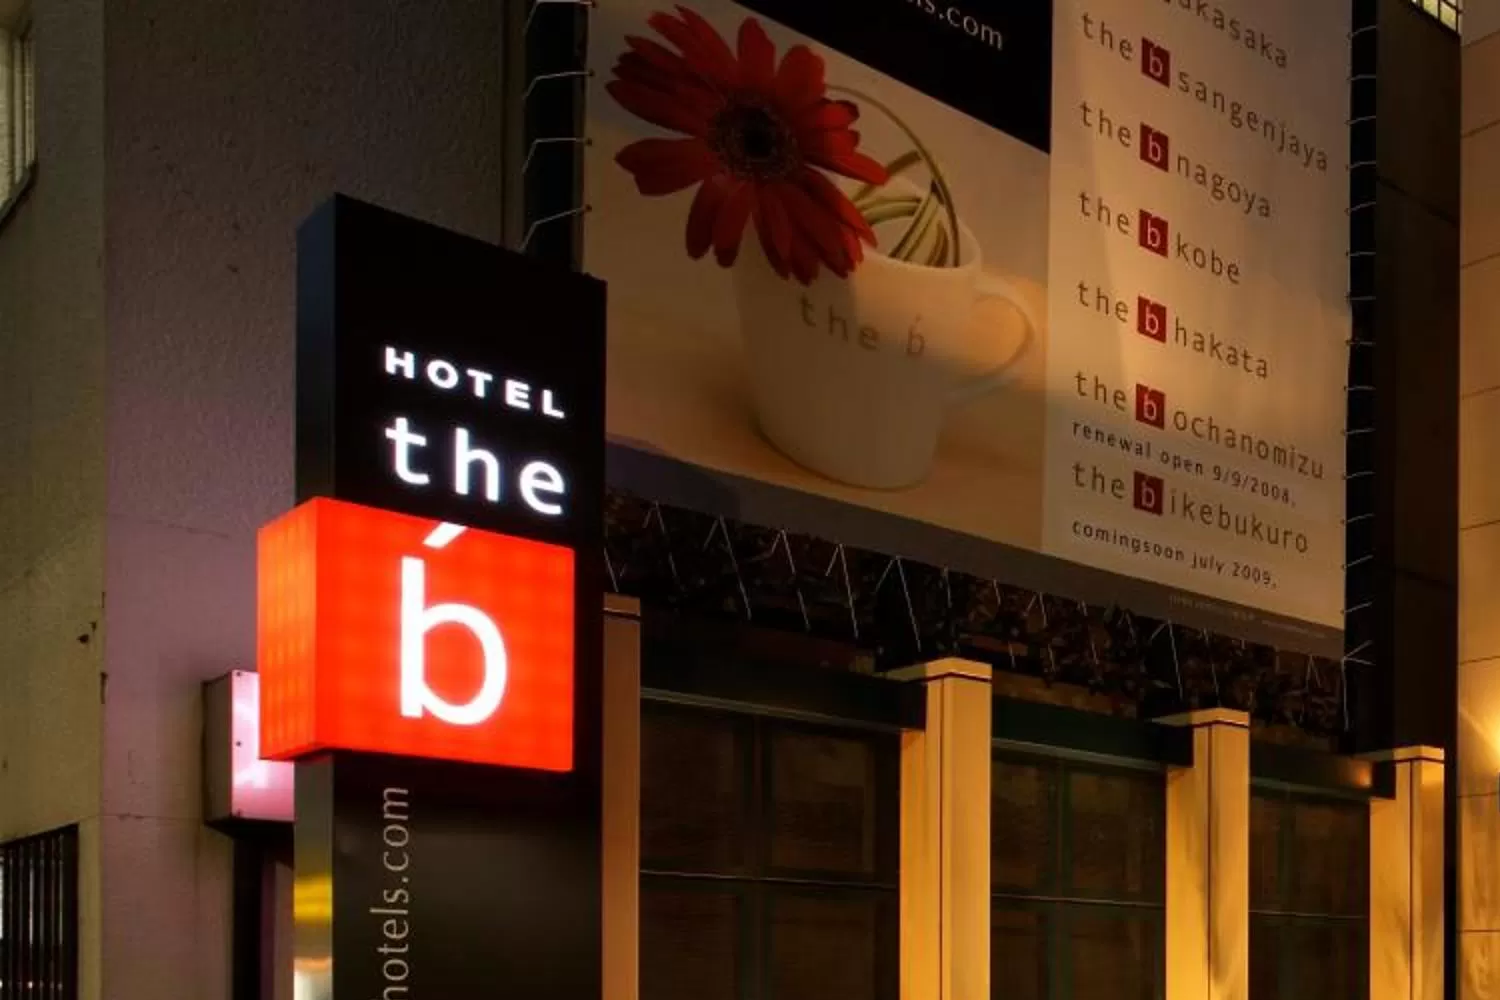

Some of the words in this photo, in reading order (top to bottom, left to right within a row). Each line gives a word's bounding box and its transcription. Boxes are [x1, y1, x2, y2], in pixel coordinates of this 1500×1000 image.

[1081, 12, 1132, 61] the
[1178, 70, 1328, 173] sangenjaya
[1079, 101, 1131, 147] the
[1176, 153, 1271, 219] nagoya
[1078, 191, 1130, 234] the
[1176, 233, 1241, 285] kobe
[800, 291, 880, 352] the
[1077, 280, 1129, 322] the
[1174, 317, 1269, 379] hakata
[384, 346, 565, 419] HOTEL
[1074, 371, 1127, 412] the
[1173, 409, 1324, 480] ochanomizu
[384, 416, 566, 515] the
[1072, 420, 1151, 459] renewal
[1160, 448, 1204, 475] open
[1072, 462, 1125, 499] the
[1170, 487, 1309, 554] ikebukuro
